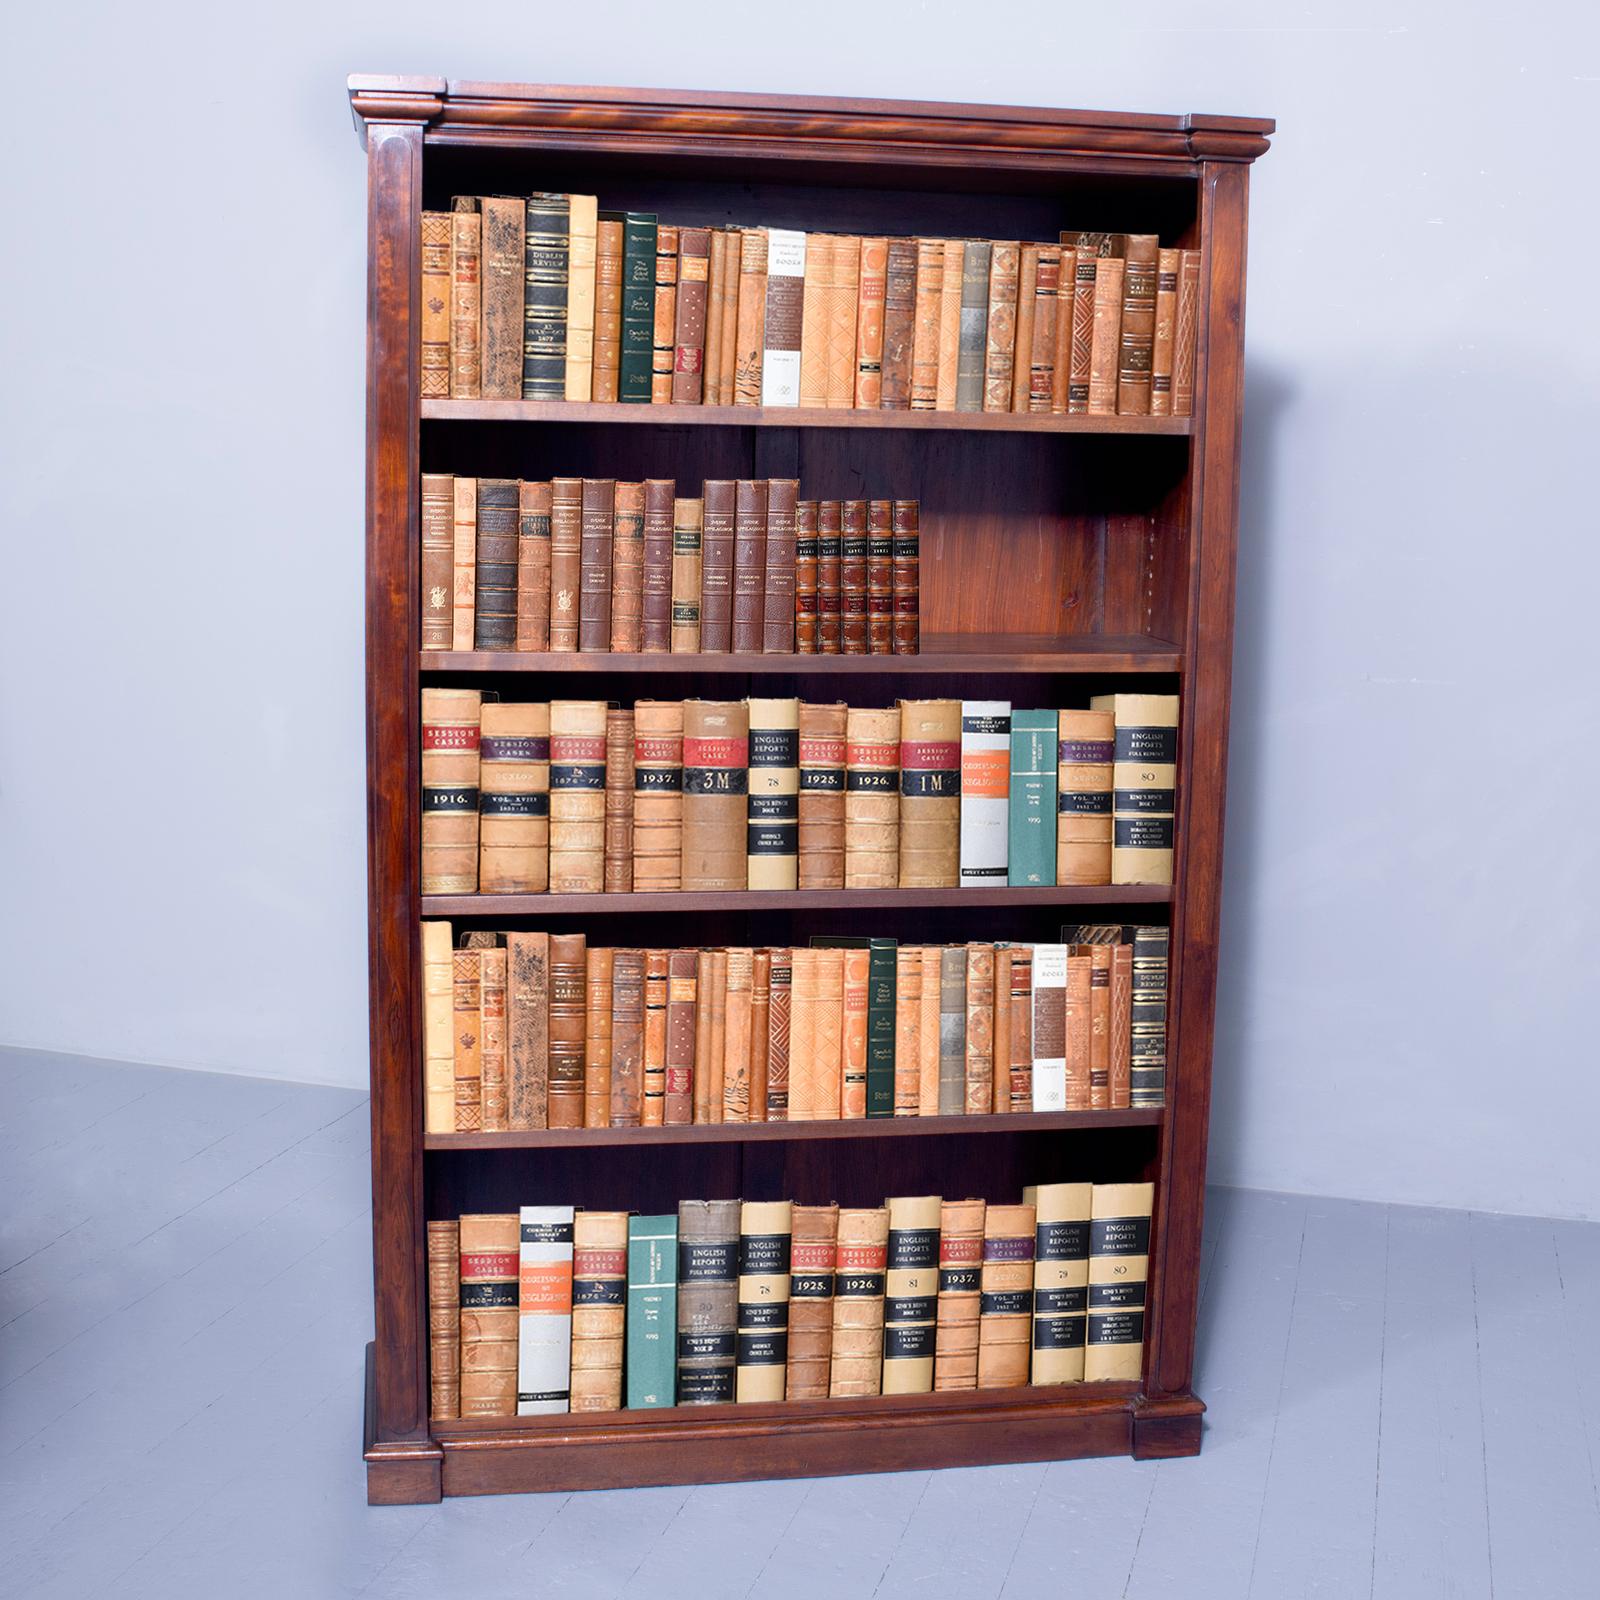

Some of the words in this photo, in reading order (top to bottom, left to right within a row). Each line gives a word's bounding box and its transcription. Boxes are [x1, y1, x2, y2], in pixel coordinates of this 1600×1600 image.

[434, 738, 467, 746] CASES
[754, 736, 790, 744] ENGLISH
[638, 743, 680, 751] SESSION
[754, 745, 789, 753] REPORTS
[1130, 741, 1163, 749] REPORTS
[643, 774, 675, 783] 1937.
[703, 772, 714, 790] 3
[716, 772, 731, 790] M
[807, 775, 838, 785] 1925.
[858, 776, 890, 786] 1926.
[931, 774, 943, 791] M
[433, 794, 468, 804] 1916.
[1106, 1224, 1137, 1232] ENGLISH
[898, 1237, 930, 1245] ENGLISH
[1049, 1237, 1080, 1245] REPORTS
[1105, 1233, 1136, 1241] REPORTS
[748, 1242, 781, 1250] ENGLISH
[943, 1243, 980, 1251] SESSION
[692, 1249, 727, 1257] ENGLISH
[748, 1251, 780, 1259] REPORTS
[842, 1250, 883, 1258] SESSION
[691, 1258, 726, 1266] REPORTS
[946, 1274, 976, 1284] 1937.
[797, 1281, 827, 1291] 1925.
[846, 1280, 876, 1290] 1926.
